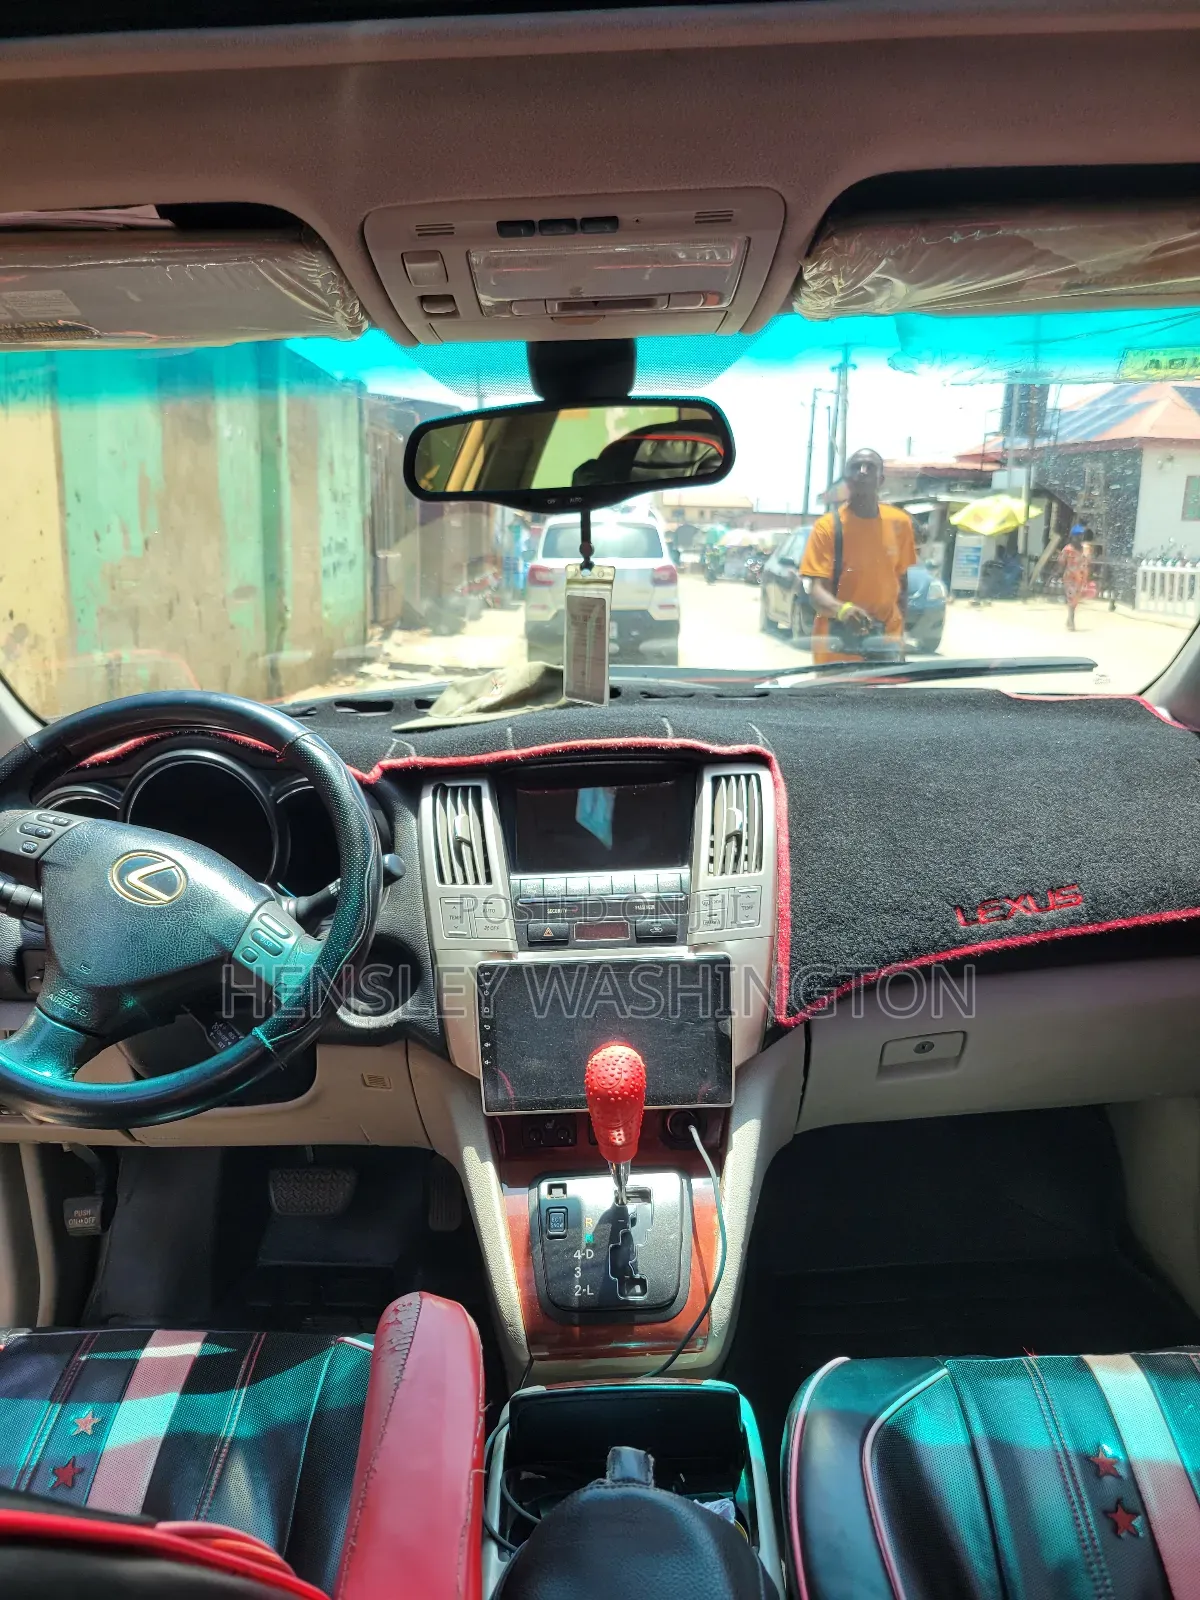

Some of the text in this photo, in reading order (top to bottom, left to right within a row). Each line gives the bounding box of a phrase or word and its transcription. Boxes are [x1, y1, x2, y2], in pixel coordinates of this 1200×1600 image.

[953, 884, 1083, 926] LEXUS
[46, 993, 89, 1018] AIRBAG
[73, 1209, 92, 1218] PUSH
[584, 1217, 593, 1228] R
[573, 1248, 594, 1260] 4-D
[574, 1266, 582, 1279] 3
